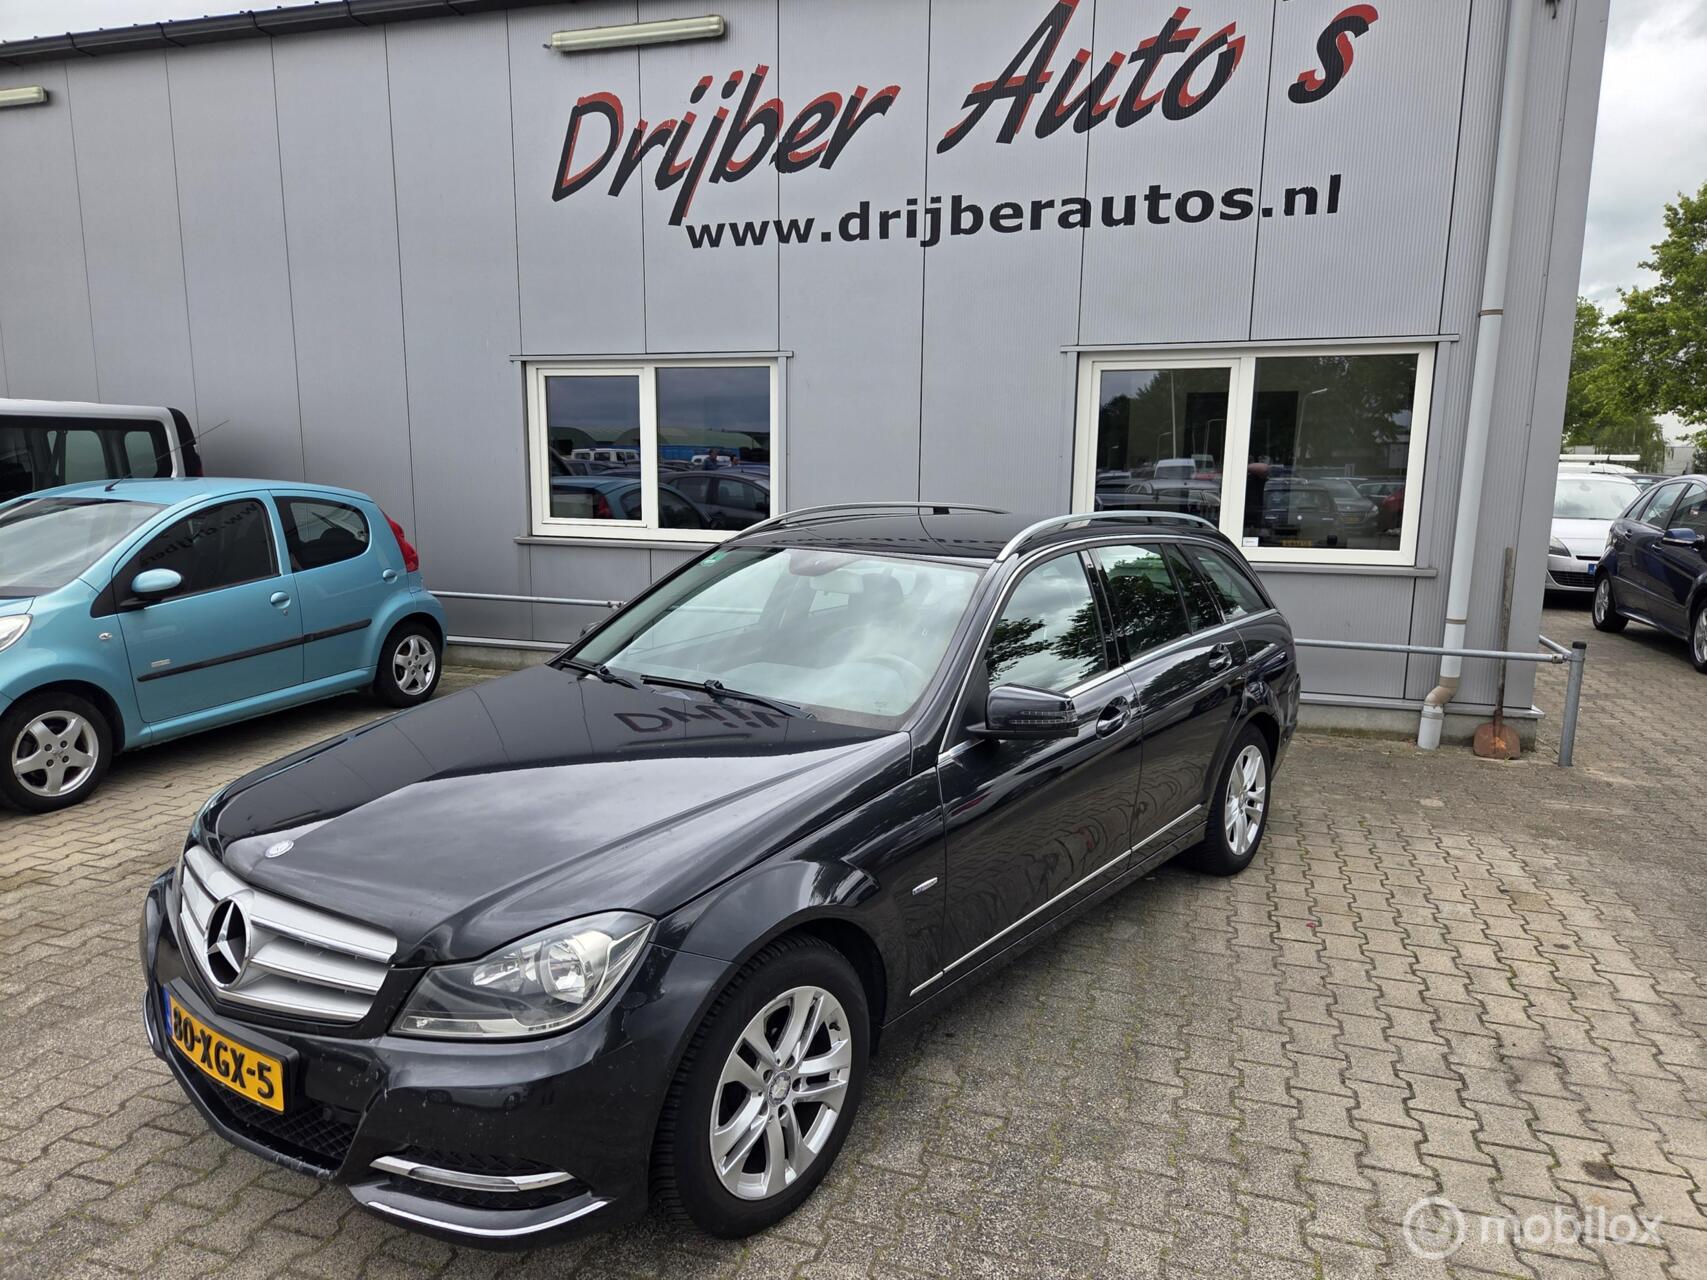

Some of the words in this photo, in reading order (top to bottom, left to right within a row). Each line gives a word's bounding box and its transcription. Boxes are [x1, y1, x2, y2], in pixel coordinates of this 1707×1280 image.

[552, 64, 901, 226] Drijber
[686, 174, 1341, 248] www.drijberautos.nl
[172, 1006, 275, 1099] 80-XGX-5
